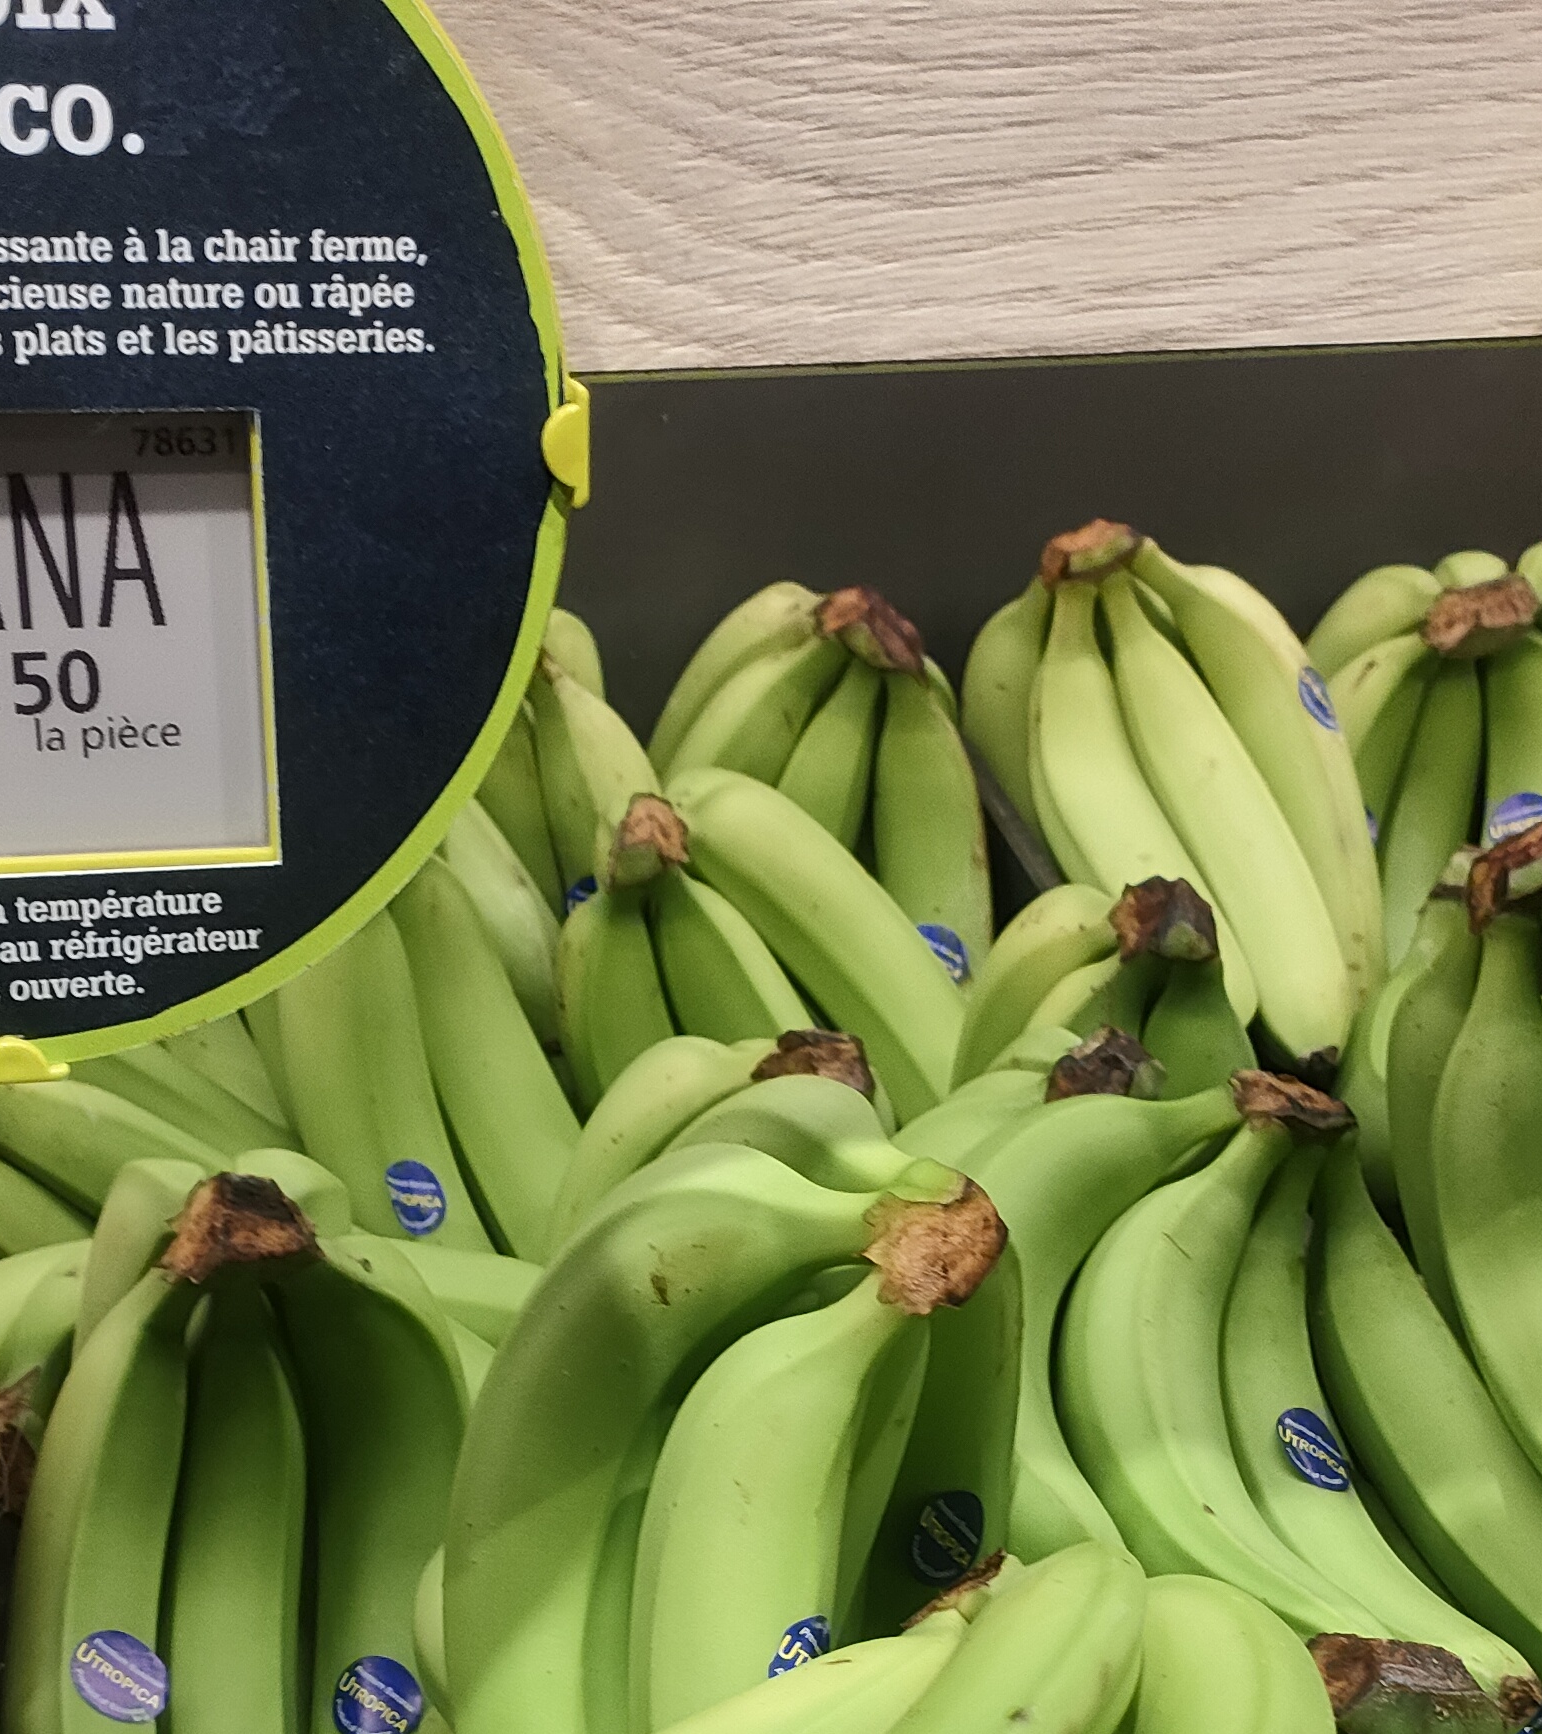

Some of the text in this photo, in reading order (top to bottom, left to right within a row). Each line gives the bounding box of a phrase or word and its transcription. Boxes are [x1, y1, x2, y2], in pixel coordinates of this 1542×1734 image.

[122, 230, 146, 265] à
[155, 229, 193, 264] la
[204, 228, 299, 264] chair
[308, 228, 429, 268] ferme,
[122, 277, 244, 310] nature
[254, 284, 301, 310] ou
[312, 275, 415, 319] râpée
[14, 321, 107, 364] plats
[117, 325, 155, 356] et
[163, 320, 219, 356] les
[227, 318, 436, 363] pâtisseries.
[132, 427, 235, 456] 78631
[34, 717, 182, 759] la pièce
[15, 888, 223, 930] température
[0, 938, 41, 964] au
[49, 923, 263, 964] réfrigérateur
[9, 969, 146, 1001] ouverte.
[1278, 1425, 1348, 1478] UTROPICA
[76, 1642, 159, 1709] UTROPICA
[339, 1672, 408, 1734] UTROPICA
